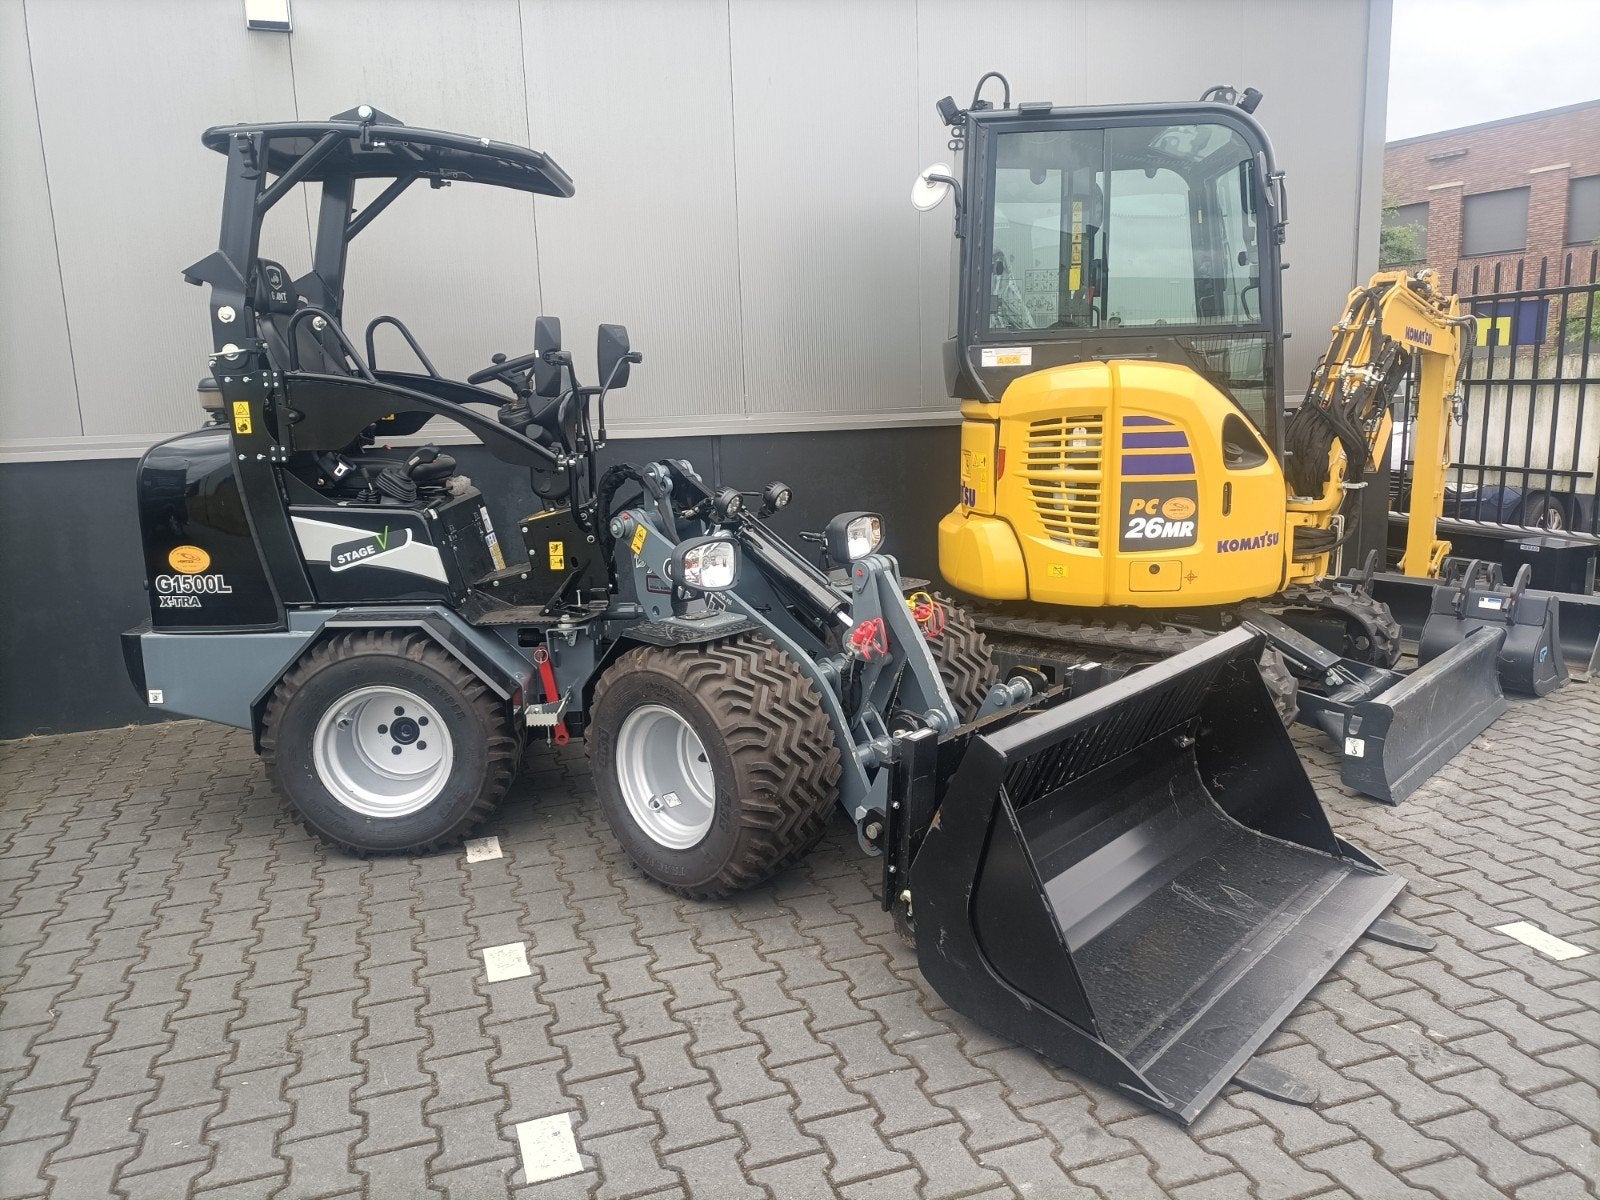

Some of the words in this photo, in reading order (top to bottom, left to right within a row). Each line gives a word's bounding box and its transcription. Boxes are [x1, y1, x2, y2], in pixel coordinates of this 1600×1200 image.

[271, 291, 287, 300] GANT
[1405, 325, 1432, 346] KOMATSU
[1128, 498, 1160, 515] PC
[1124, 517, 1195, 538] 26MR
[1217, 530, 1279, 553] KOMATSU
[337, 544, 376, 564] STAGE
[155, 574, 233, 594] G1500L
[158, 595, 202, 608] X-TRA
